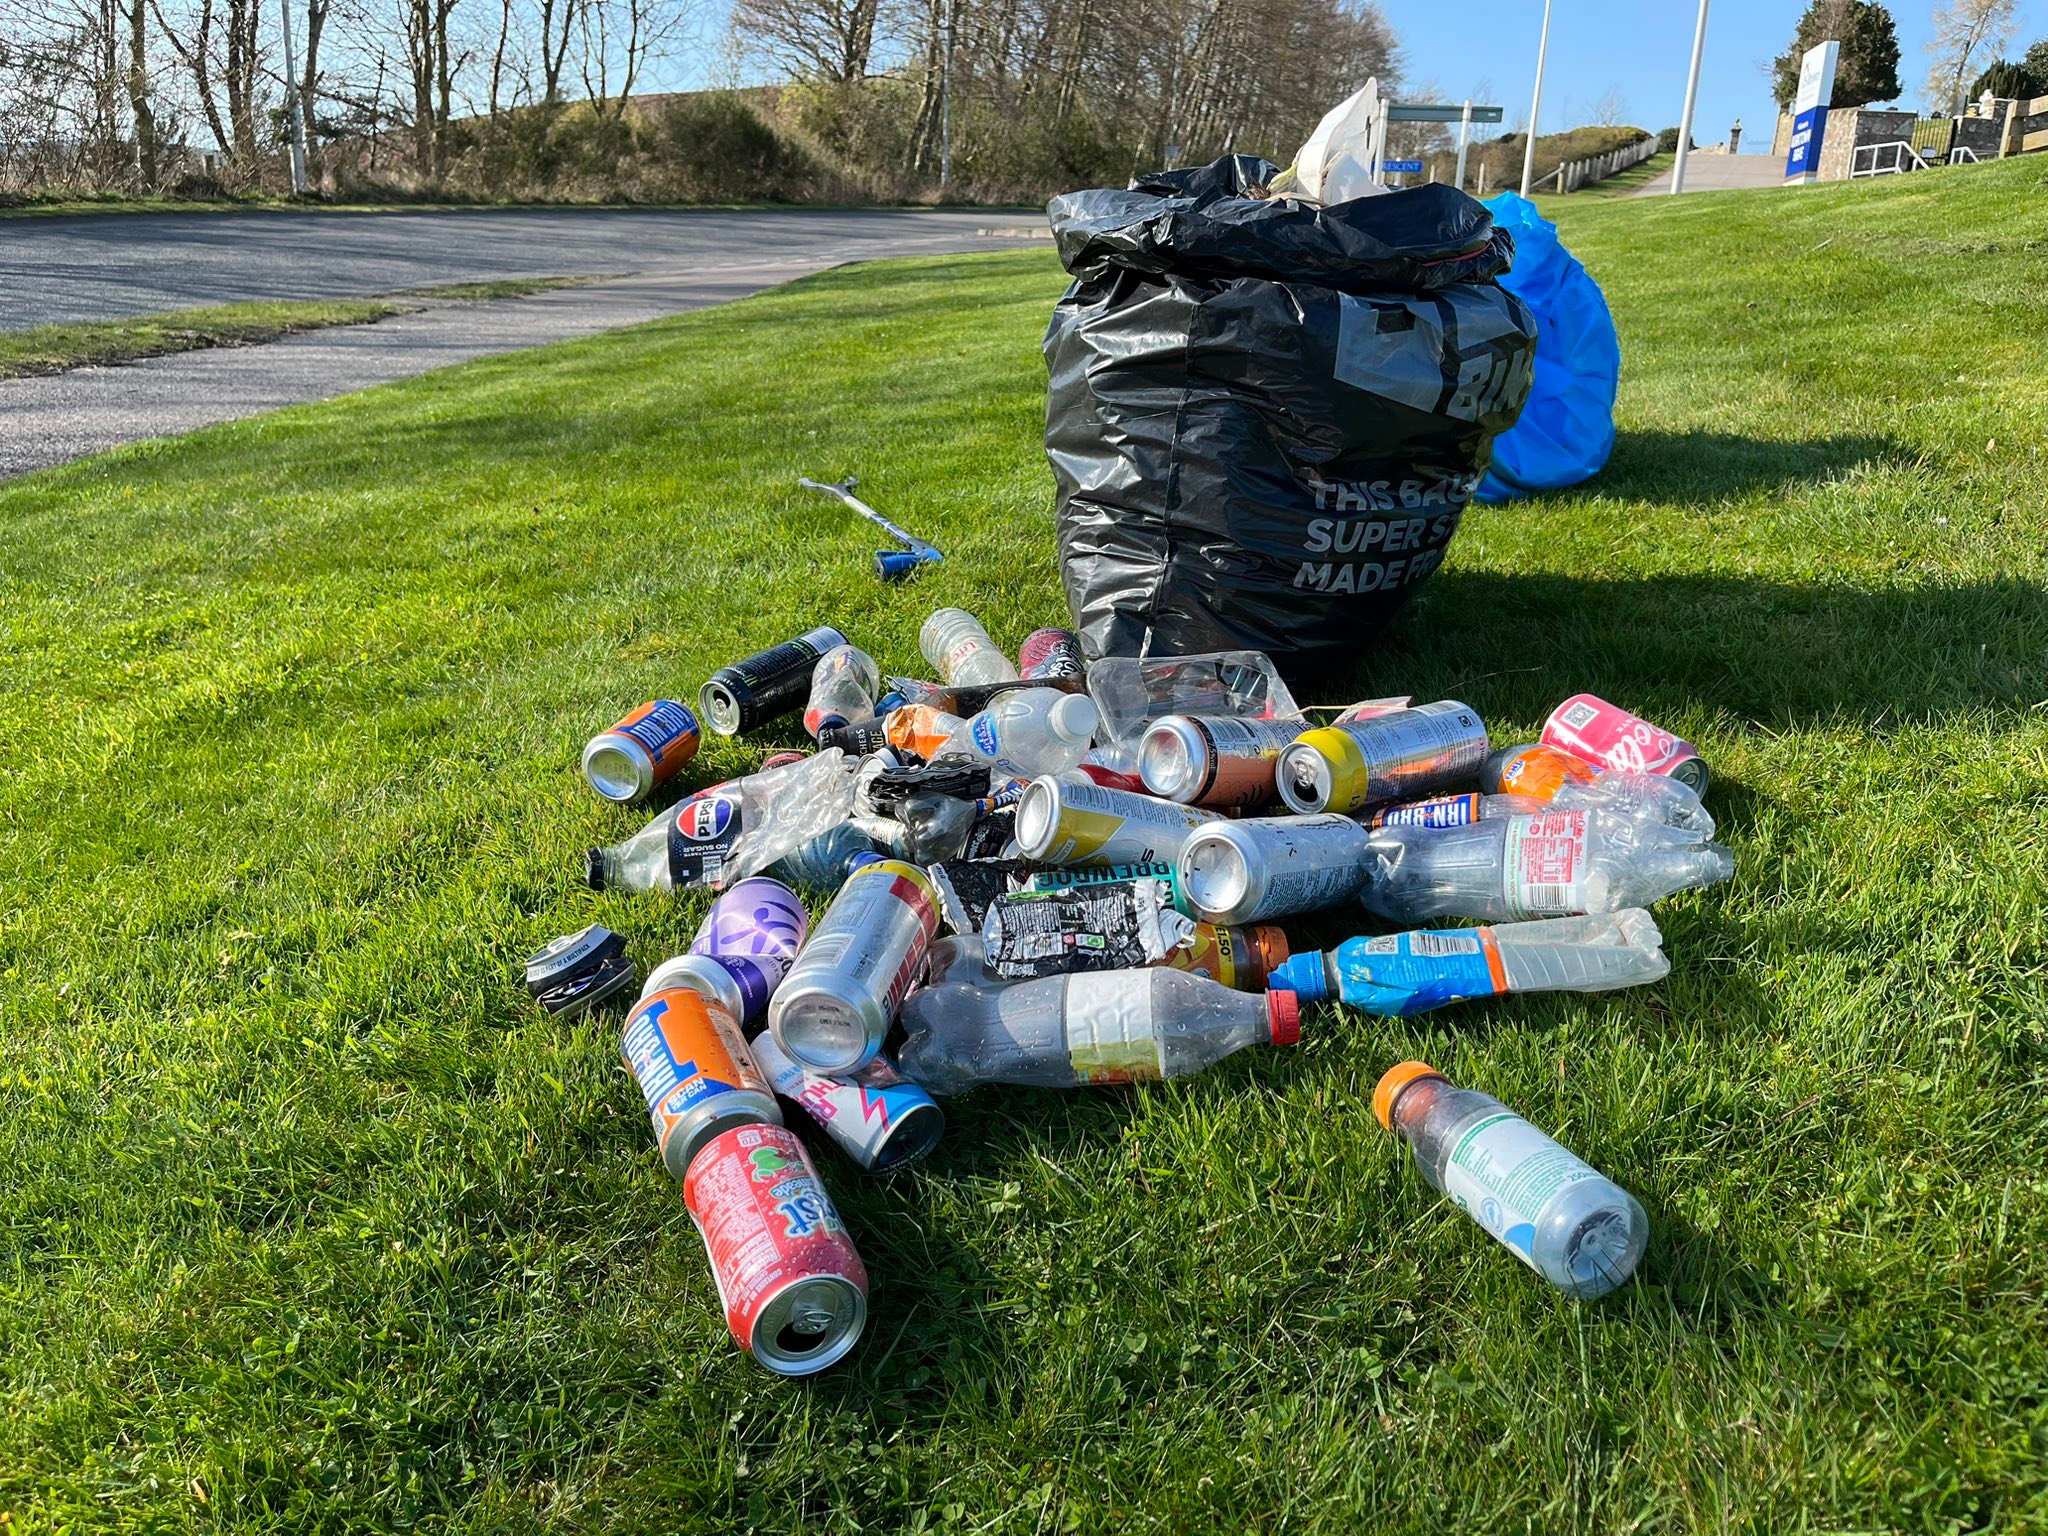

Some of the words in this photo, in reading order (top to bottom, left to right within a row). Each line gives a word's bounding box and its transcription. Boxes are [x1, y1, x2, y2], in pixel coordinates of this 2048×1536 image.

[1383, 161, 1420, 171] RESCENT
[1307, 479, 1394, 511] THIS
[1304, 517, 1426, 553] SUPER
[1293, 561, 1404, 594] MADE
[697, 799, 715, 838] PEPSI
[683, 844, 714, 854] SUGAR
[714, 842, 728, 851] NO
[773, 1177, 818, 1198] imeade
